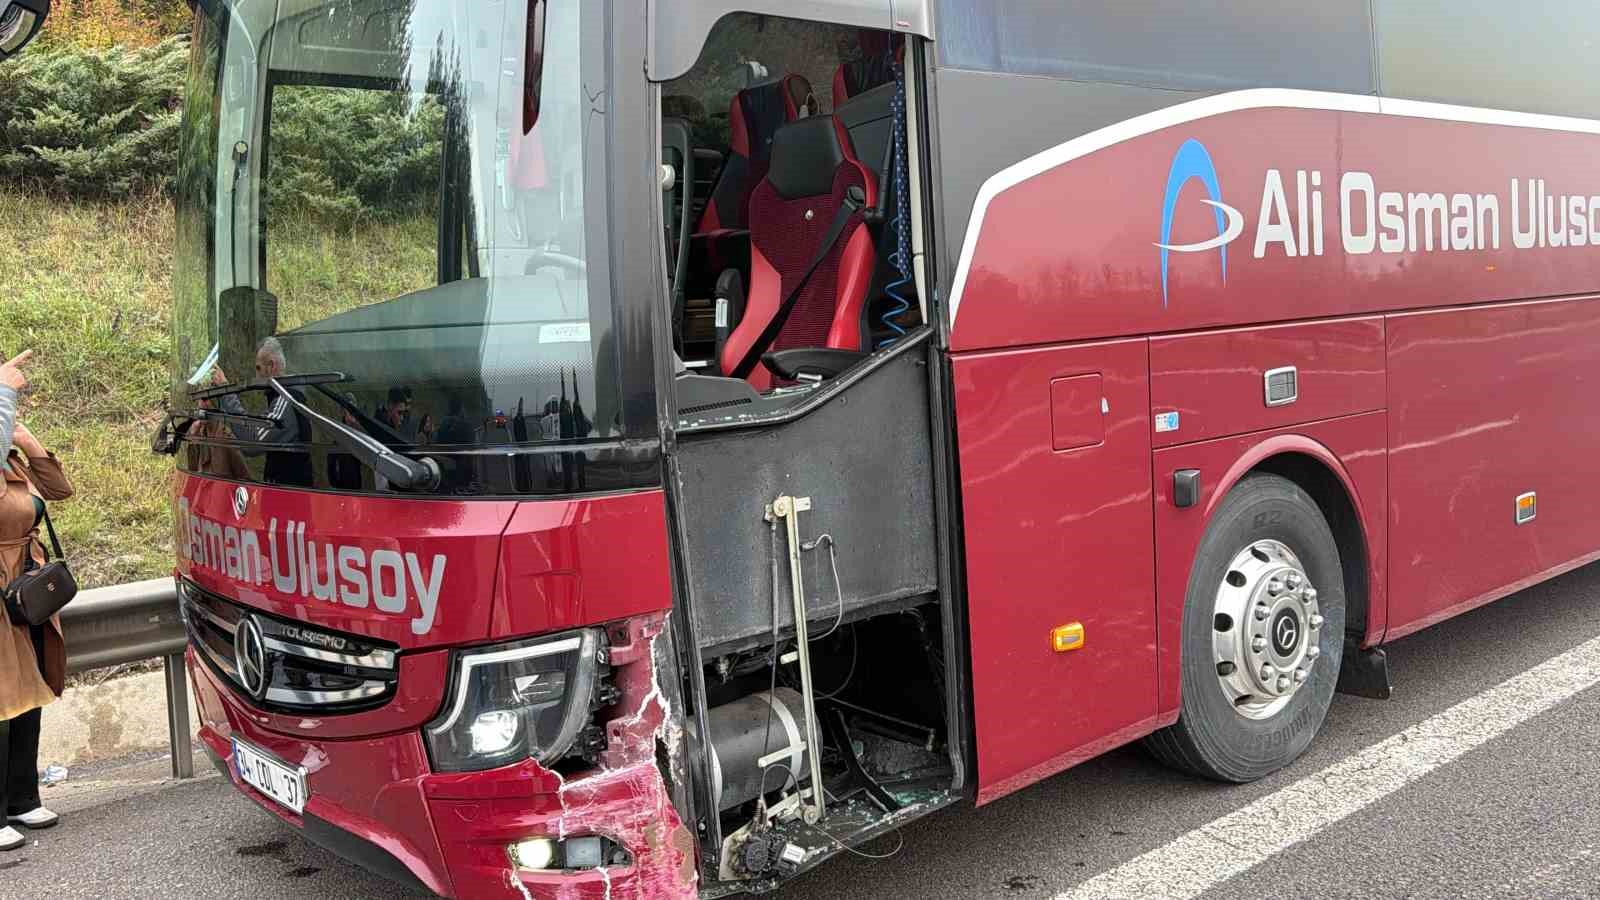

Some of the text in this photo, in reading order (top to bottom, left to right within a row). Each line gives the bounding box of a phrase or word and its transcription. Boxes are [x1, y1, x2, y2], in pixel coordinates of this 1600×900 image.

[1253, 169, 1324, 258] Ali
[1340, 171, 1500, 255] Osman
[269, 516, 447, 635] Ulusoy
[280, 624, 346, 650] TOURISMO
[283, 774, 298, 806] 37
